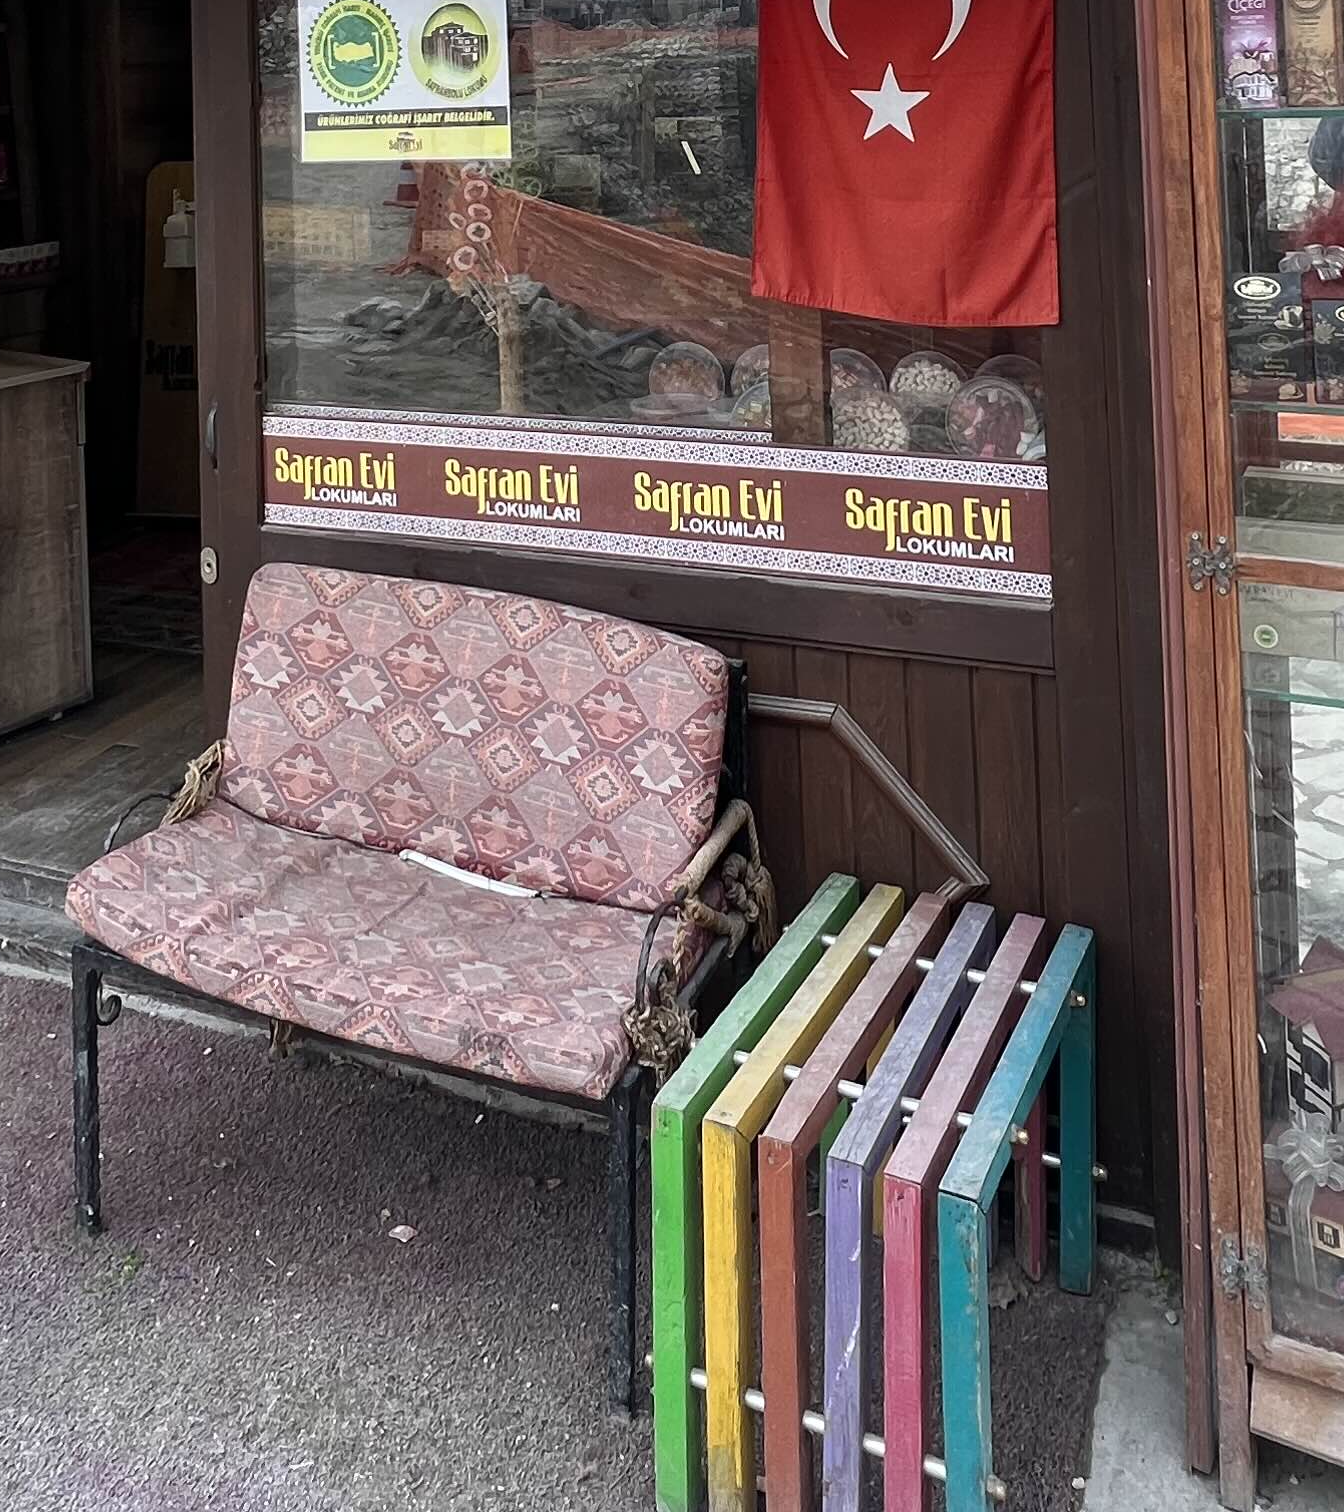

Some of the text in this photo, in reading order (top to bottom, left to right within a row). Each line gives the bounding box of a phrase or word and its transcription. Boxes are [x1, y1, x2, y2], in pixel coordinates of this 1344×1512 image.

[275, 447, 395, 500] Safran Evi
[445, 458, 579, 514] Safran Evi
[311, 487, 397, 507] LOKUMLARI
[485, 501, 582, 523] LOKUMLARI
[634, 471, 783, 531] Safran Evi
[679, 516, 785, 541] LOKUMLARI
[844, 487, 1012, 551] Safran Evi
[895, 534, 1015, 563] LOKUMLARI
